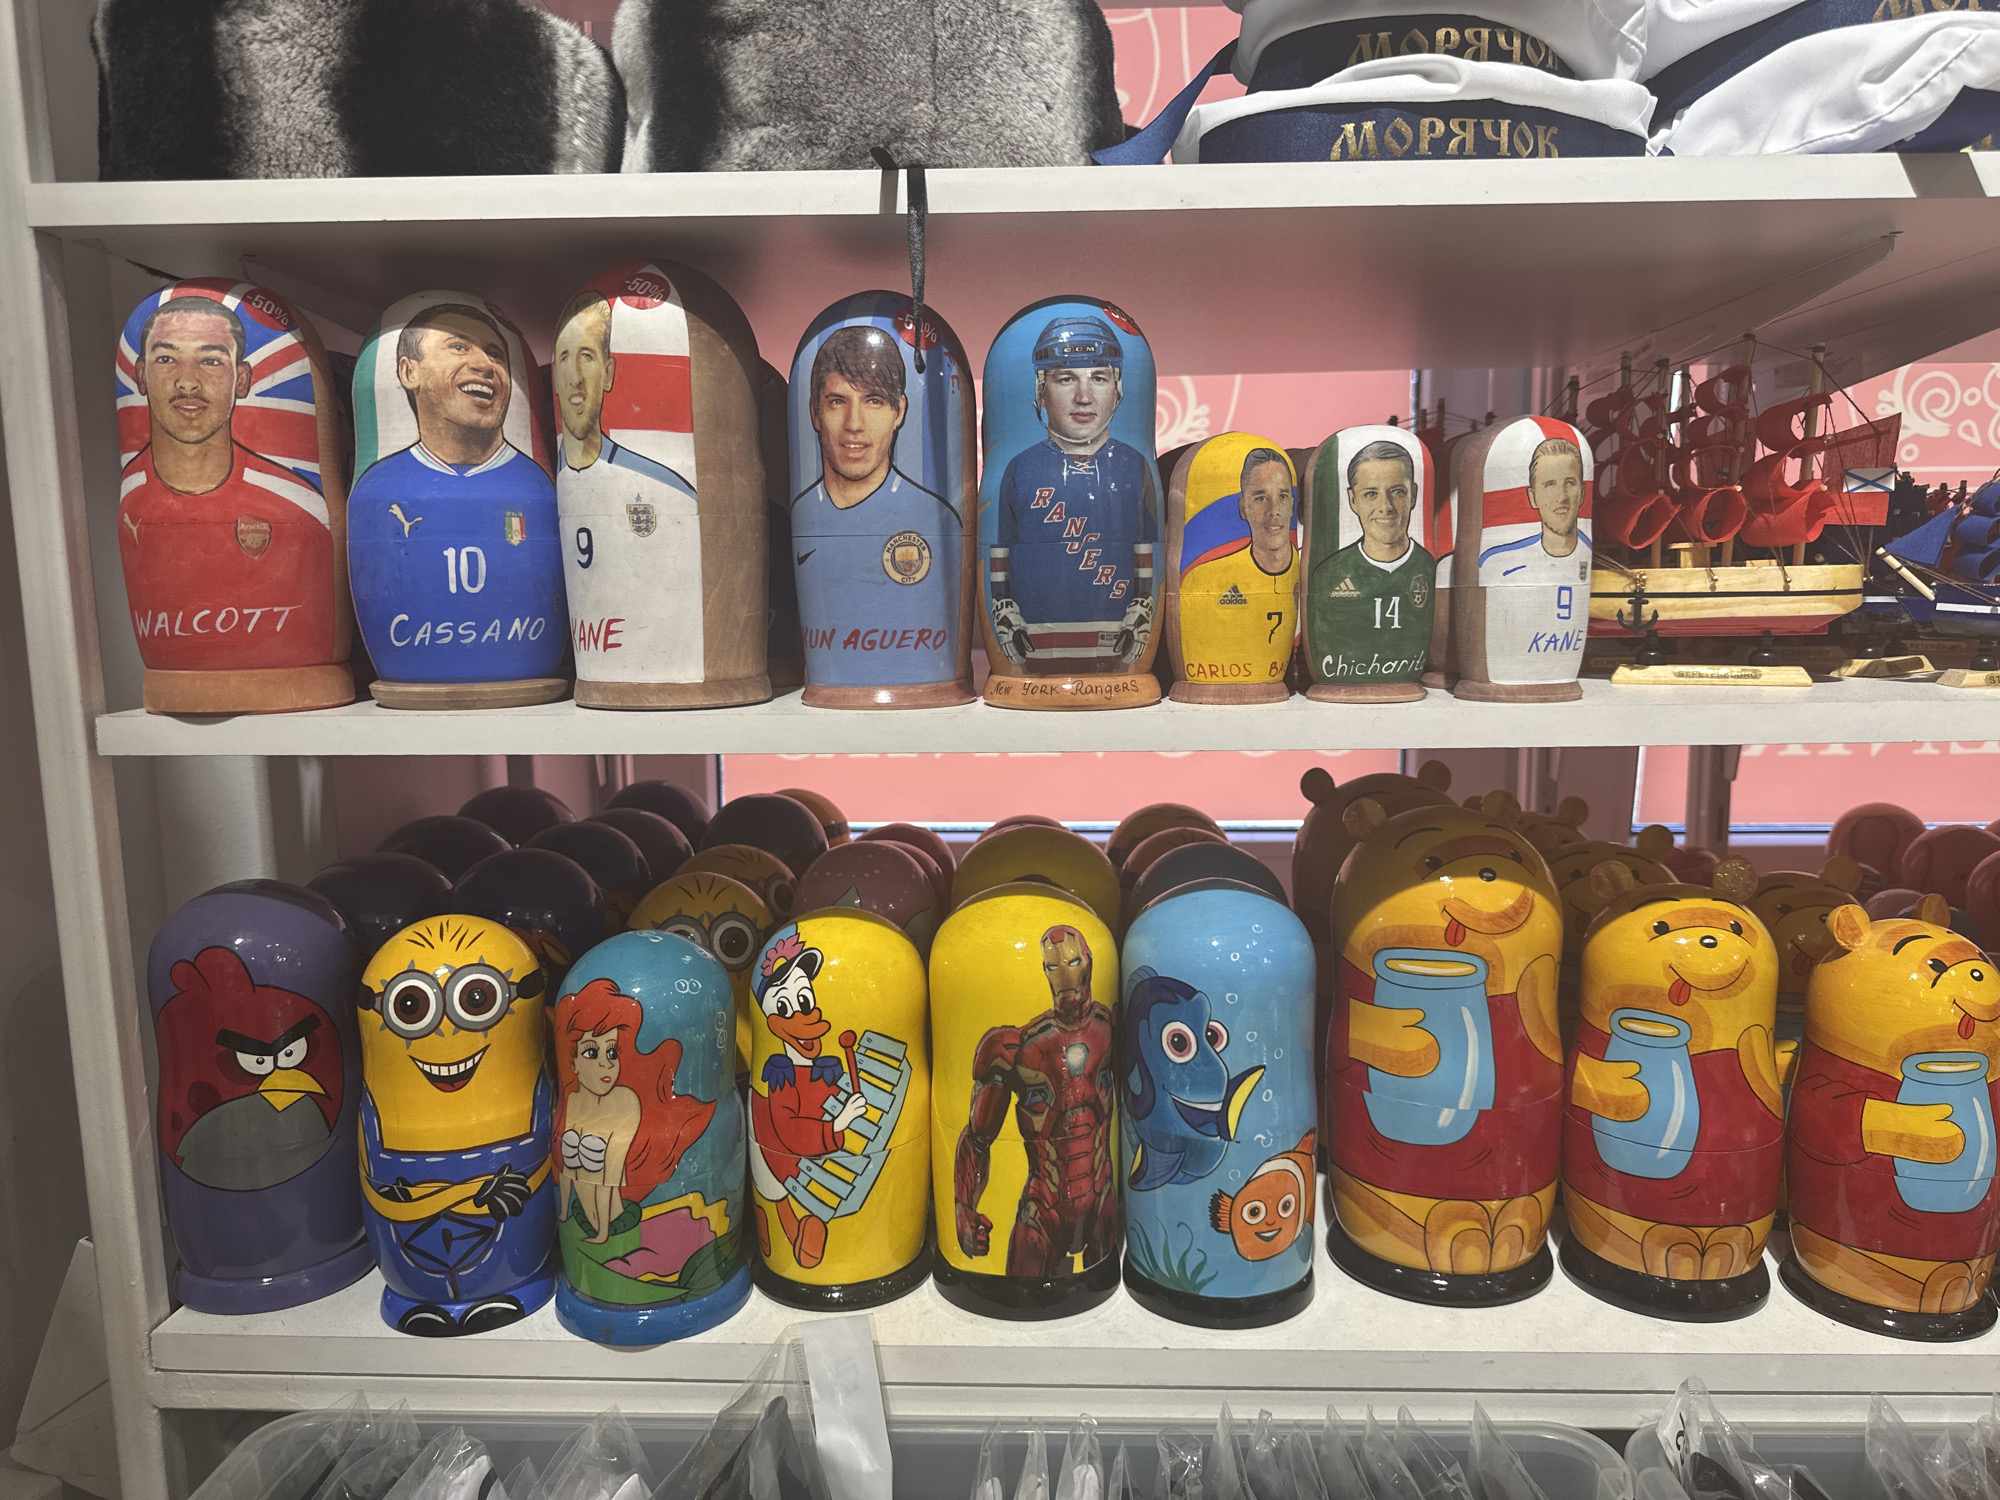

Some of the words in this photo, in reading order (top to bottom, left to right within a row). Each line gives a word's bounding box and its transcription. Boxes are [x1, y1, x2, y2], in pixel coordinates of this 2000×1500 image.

[1330, 117, 1559, 161] МОРЯЧОК
[625, 277, 666, 303] -50%
[246, 294, 289, 326] -50%
[897, 313, 938, 343] -5%
[239, 522, 269, 531] Arsenal
[1030, 487, 1130, 599] RANGERS
[576, 526, 594, 569] 9
[886, 535, 926, 553] MANCHESTER
[443, 546, 487, 594] 10
[1373, 596, 1402, 629] 14
[1556, 586, 1573, 620] 9
[134, 605, 302, 639] WALCOTT
[390, 613, 546, 647] CASSANO
[571, 616, 626, 654] KANE
[1267, 611, 1283, 645] 7
[843, 628, 947, 651] AGUERO
[1527, 628, 1584, 653] KANE
[990, 680, 1013, 696] New
[1186, 663, 1253, 680] CARLOS
